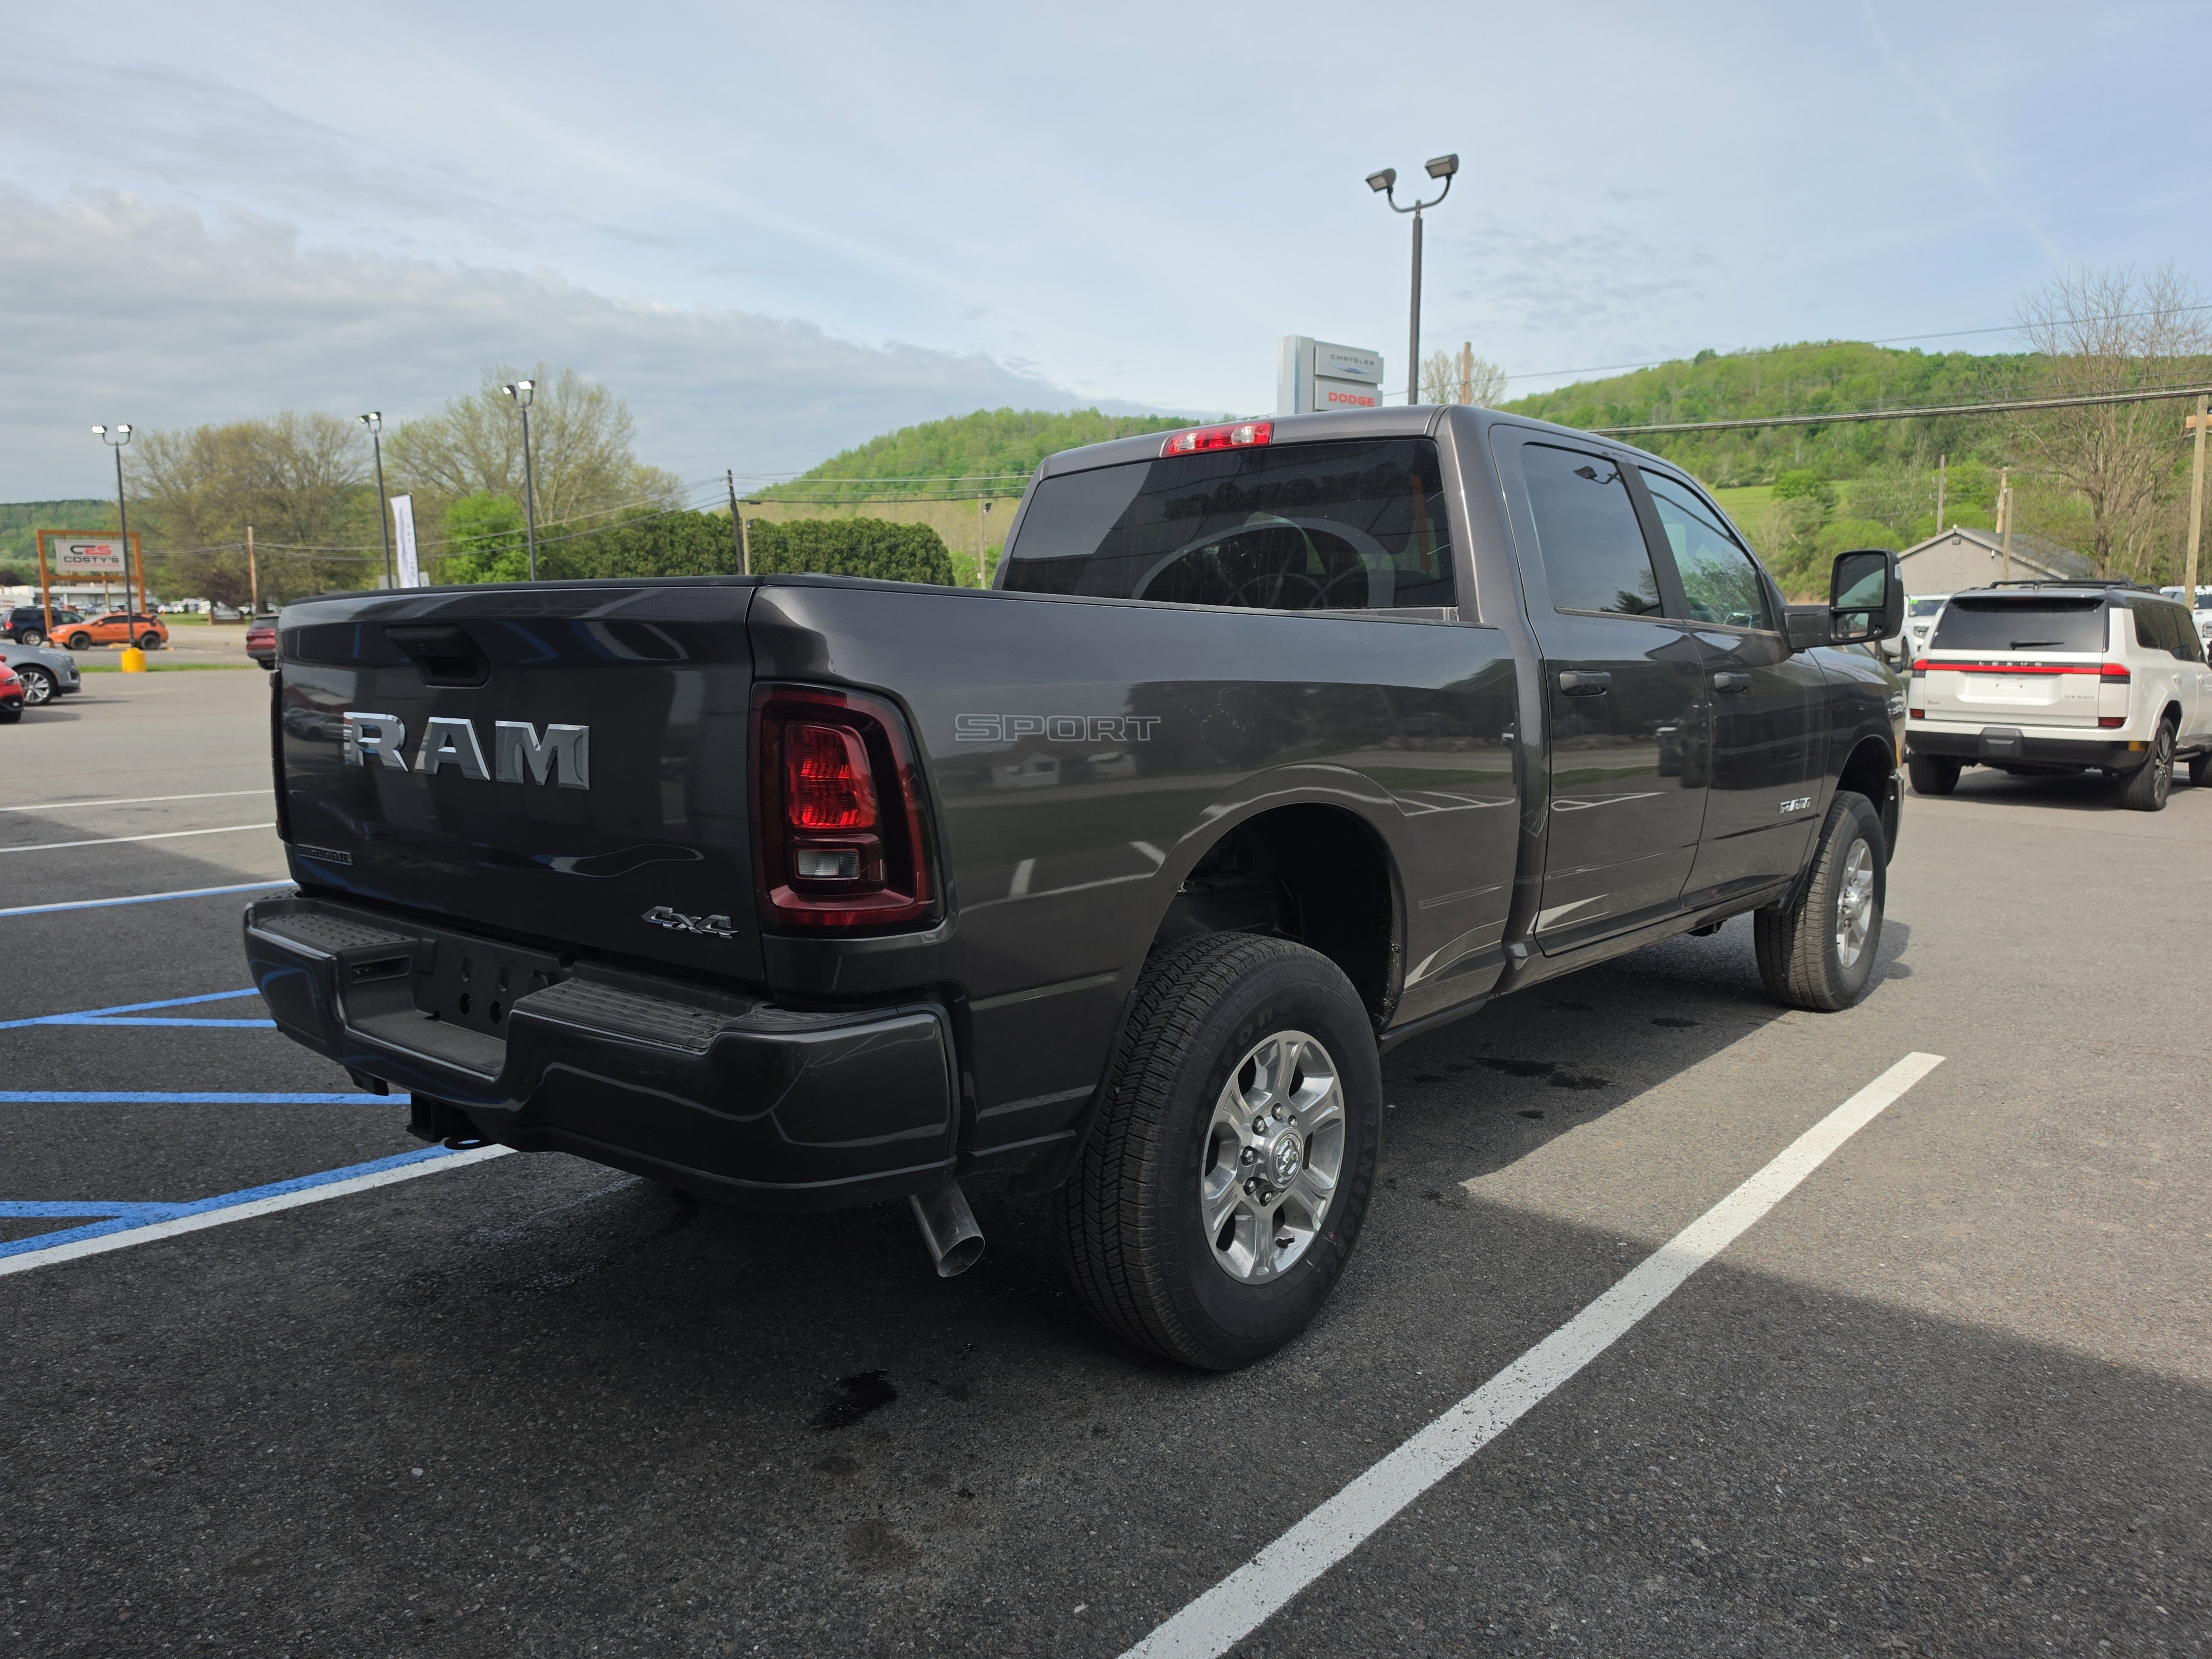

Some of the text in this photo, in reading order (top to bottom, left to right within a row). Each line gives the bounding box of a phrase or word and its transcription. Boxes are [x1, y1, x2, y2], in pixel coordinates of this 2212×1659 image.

[1330, 354, 1374, 365] CHRYSLER
[1328, 392, 1374, 407] DODGE
[954, 712, 1161, 742] SPORT
[343, 711, 590, 790] RAM
